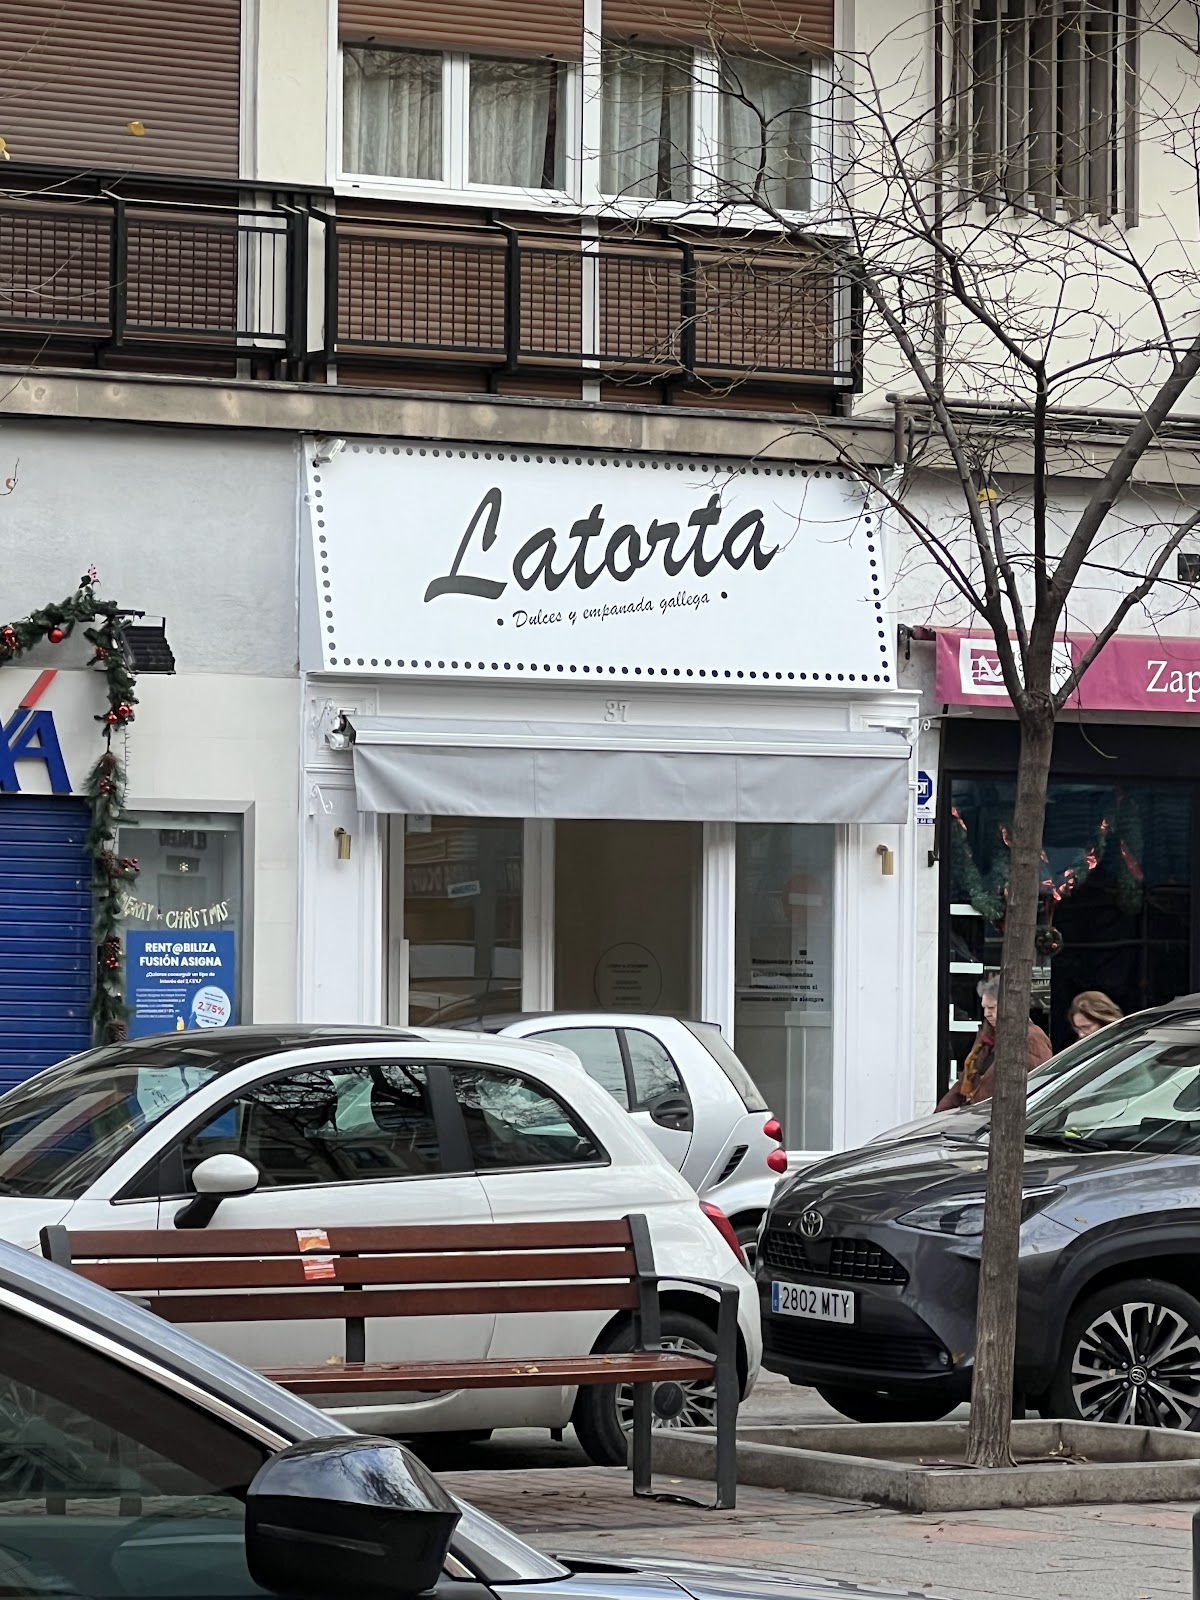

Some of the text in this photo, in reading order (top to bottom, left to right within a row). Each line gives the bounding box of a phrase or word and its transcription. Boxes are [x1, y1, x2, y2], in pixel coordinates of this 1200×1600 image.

[424, 487, 779, 602] Latorta
[512, 591, 711, 628] Dulces y empanada gallega
[1146, 660, 1200, 702] Zap
[165, 901, 229, 929] CHRISTMAS
[140, 954, 222, 966] FUSIÓN ASIGNA
[145, 943, 216, 955] RENT@BILIZA
[198, 1001, 225, 1016] 2,75%
[782, 1287, 849, 1318] 2802 MTY
